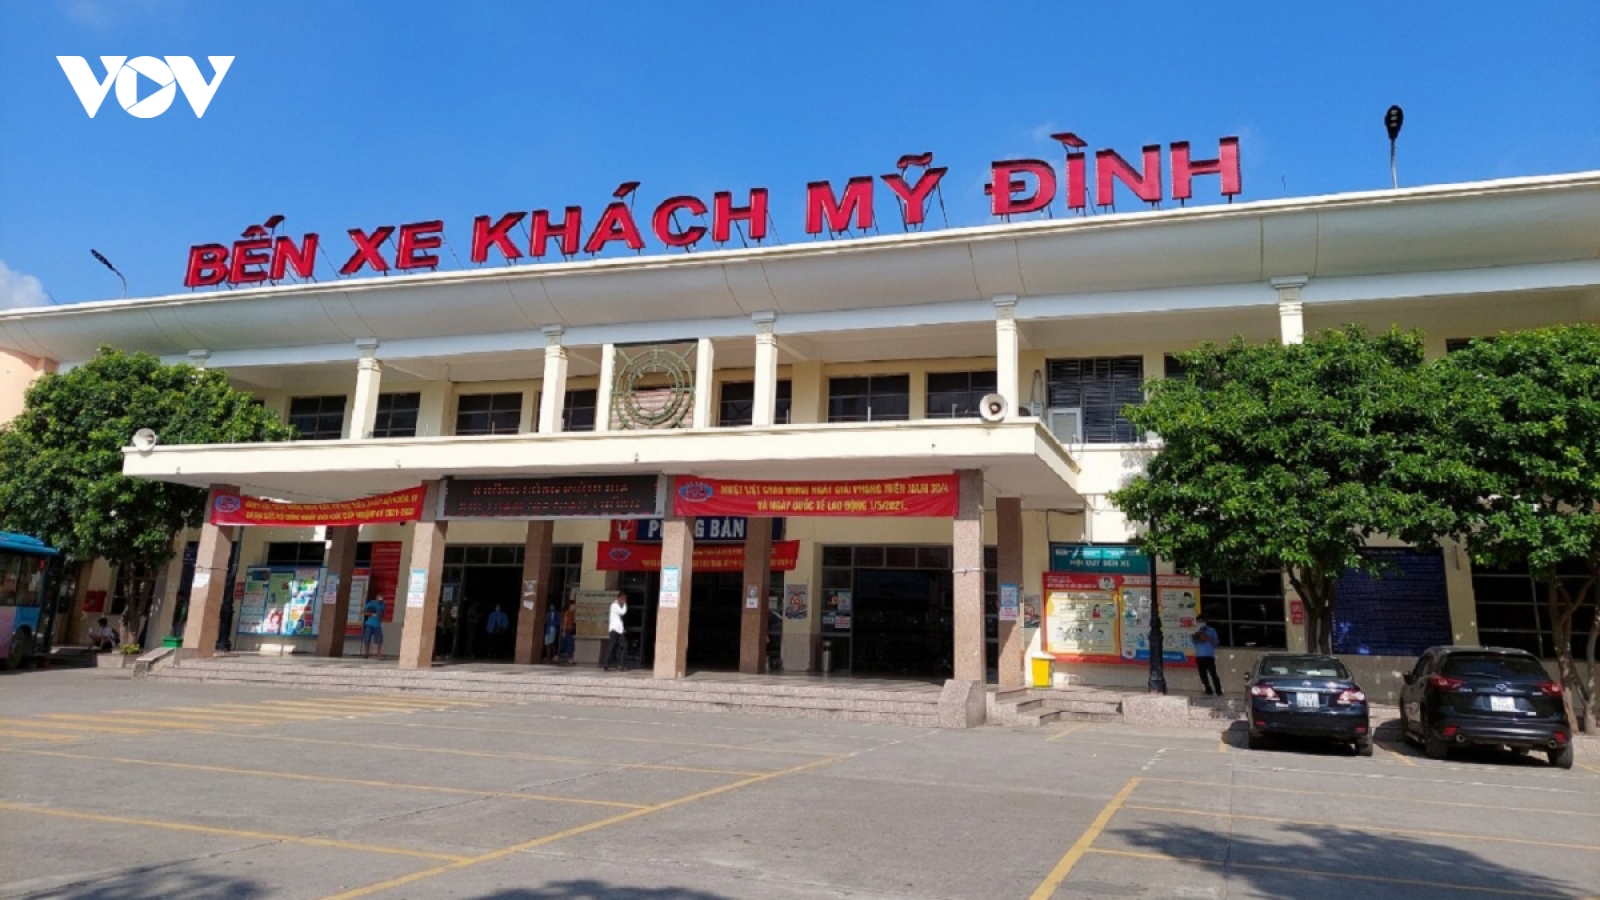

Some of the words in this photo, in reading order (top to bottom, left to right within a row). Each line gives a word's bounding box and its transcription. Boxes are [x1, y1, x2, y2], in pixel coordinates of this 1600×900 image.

[184, 215, 319, 287] BẾN
[340, 220, 444, 275] XE
[471, 181, 768, 263] KHÁCH
[806, 151, 948, 234] MỸ
[985, 132, 1241, 216] ĐÌNH
[709, 516, 745, 538] BÁN
